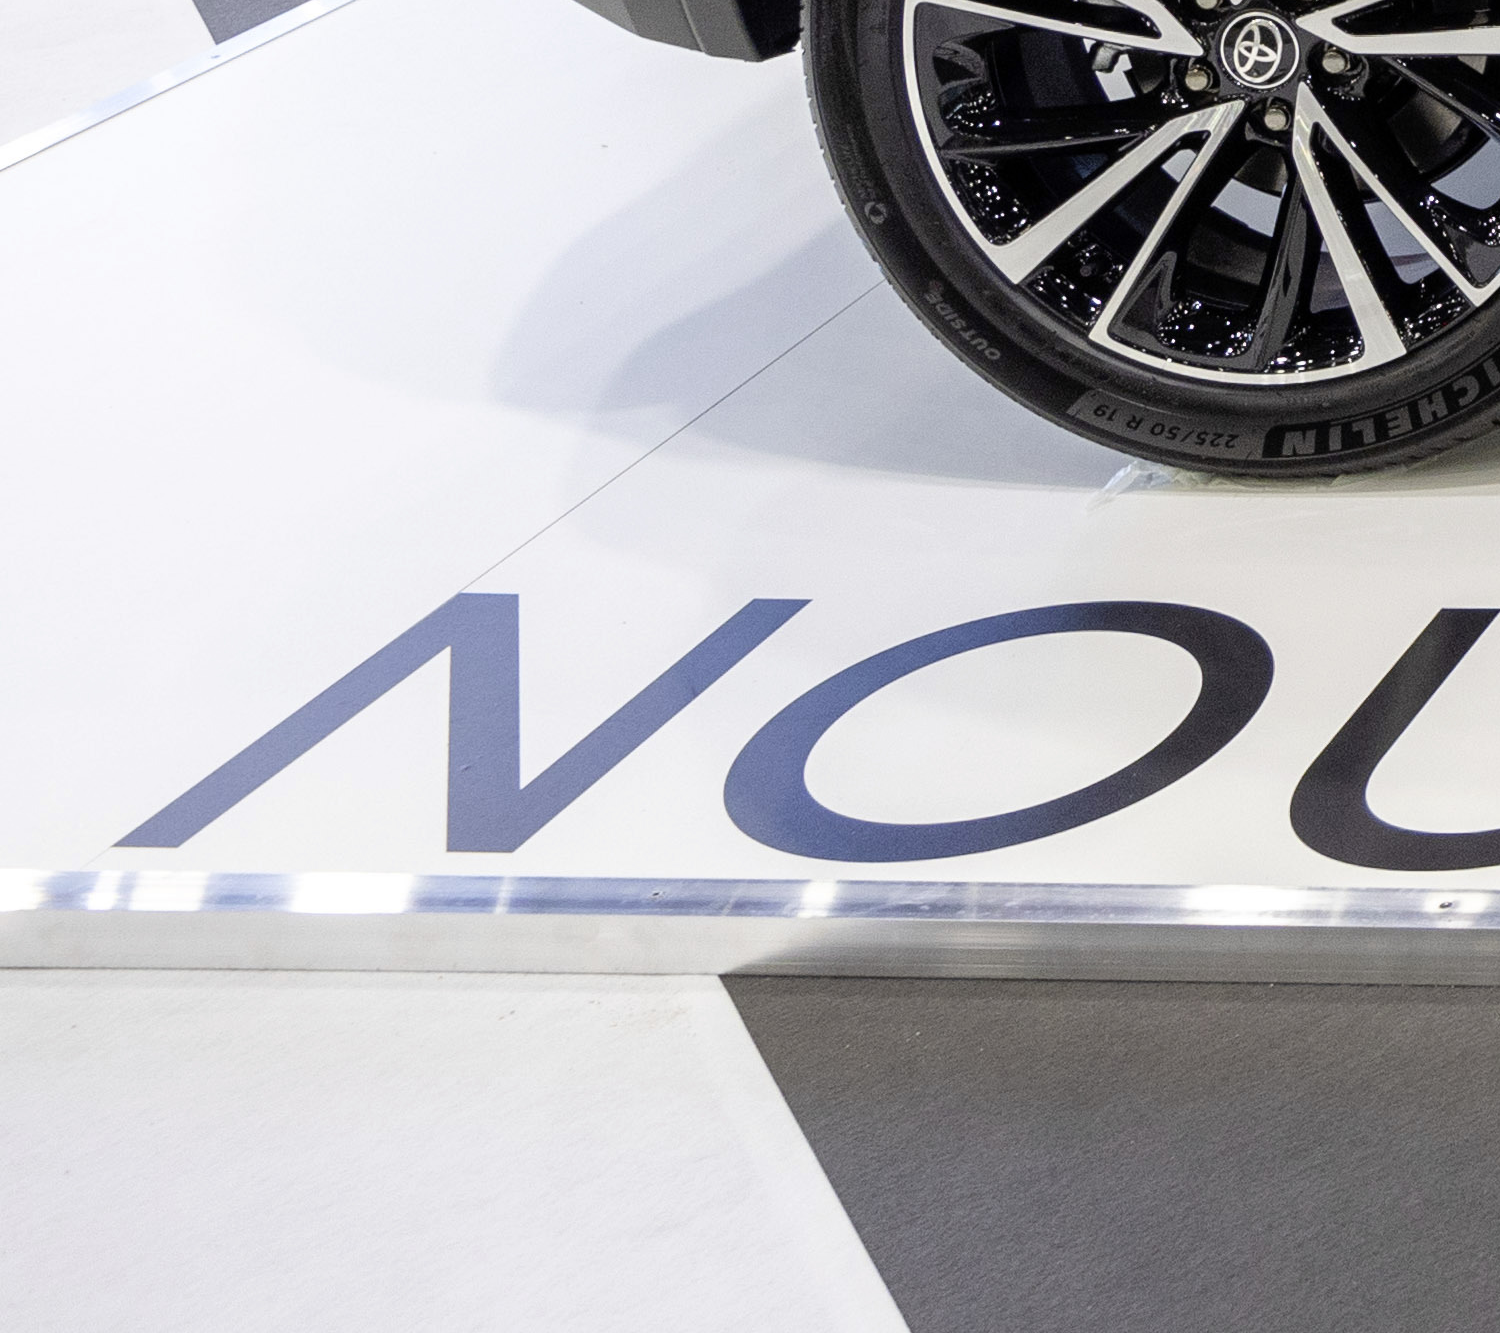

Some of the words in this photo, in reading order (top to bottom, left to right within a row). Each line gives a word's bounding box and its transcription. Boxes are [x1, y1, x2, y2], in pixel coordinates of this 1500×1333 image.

[922, 290, 1003, 362] OUTSIDE
[1092, 402, 1119, 423] 19
[1125, 413, 1144, 431] R
[1149, 421, 1240, 451] 225/50
